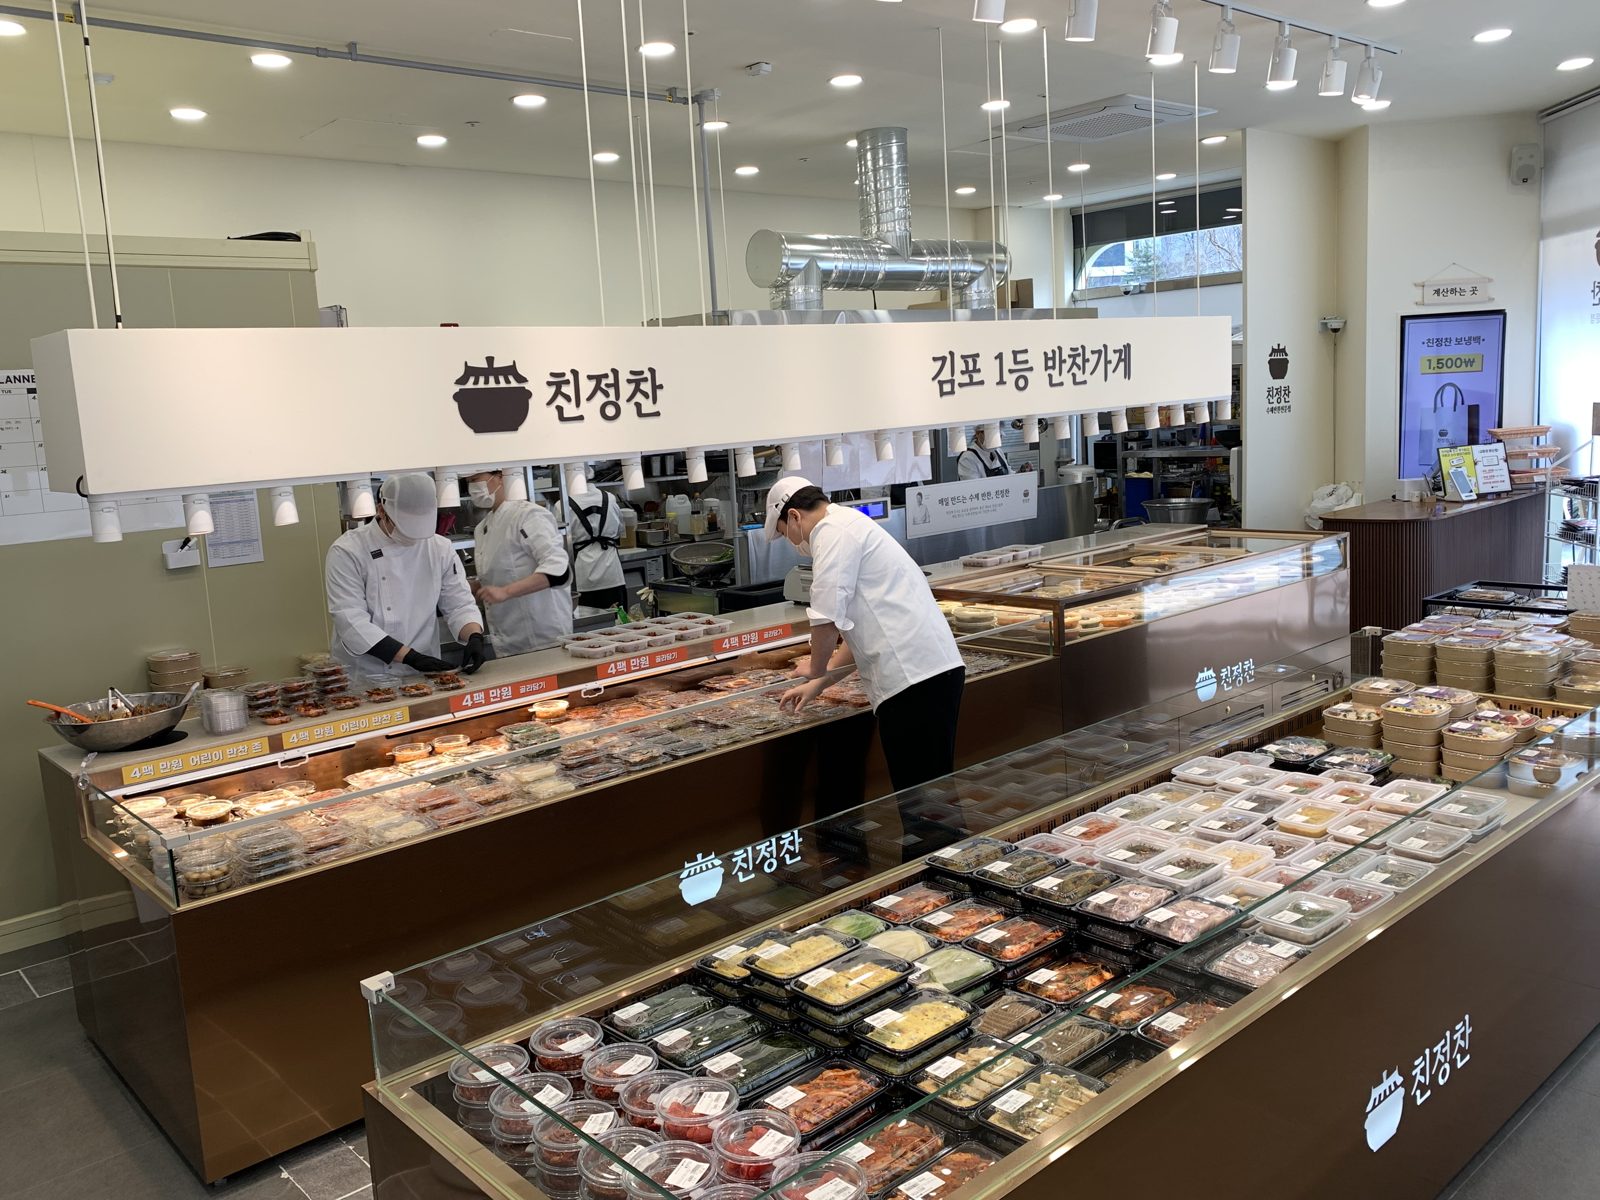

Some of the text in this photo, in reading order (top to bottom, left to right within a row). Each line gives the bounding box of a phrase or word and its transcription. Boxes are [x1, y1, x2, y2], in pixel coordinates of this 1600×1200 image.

[1432, 286, 1479, 297] 계산하는 곳
[931, 342, 1132, 398] 김포 1등 반찬가게
[546, 367, 664, 422] 친정찬
[1266, 385, 1291, 404] 친정찬
[722, 635, 739, 649] 4팩
[741, 631, 759, 645] 만원
[607, 660, 627, 675] 4팩
[630, 655, 650, 670] 만원
[1220, 658, 1255, 691] 친정찬
[462, 691, 485, 706] 4팩
[489, 685, 512, 702] 만원
[289, 730, 310, 744] 4팩
[314, 725, 335, 739] 만원
[340, 718, 369, 733] 어린이
[372, 713, 391, 726] 반찬
[130, 764, 155, 779] 4팩
[160, 758, 183, 773] 만원
[189, 750, 224, 766] 어린이
[227, 744, 249, 758] 반찬
[731, 829, 803, 883] 친정찬
[1411, 1014, 1473, 1106] 친정찬
